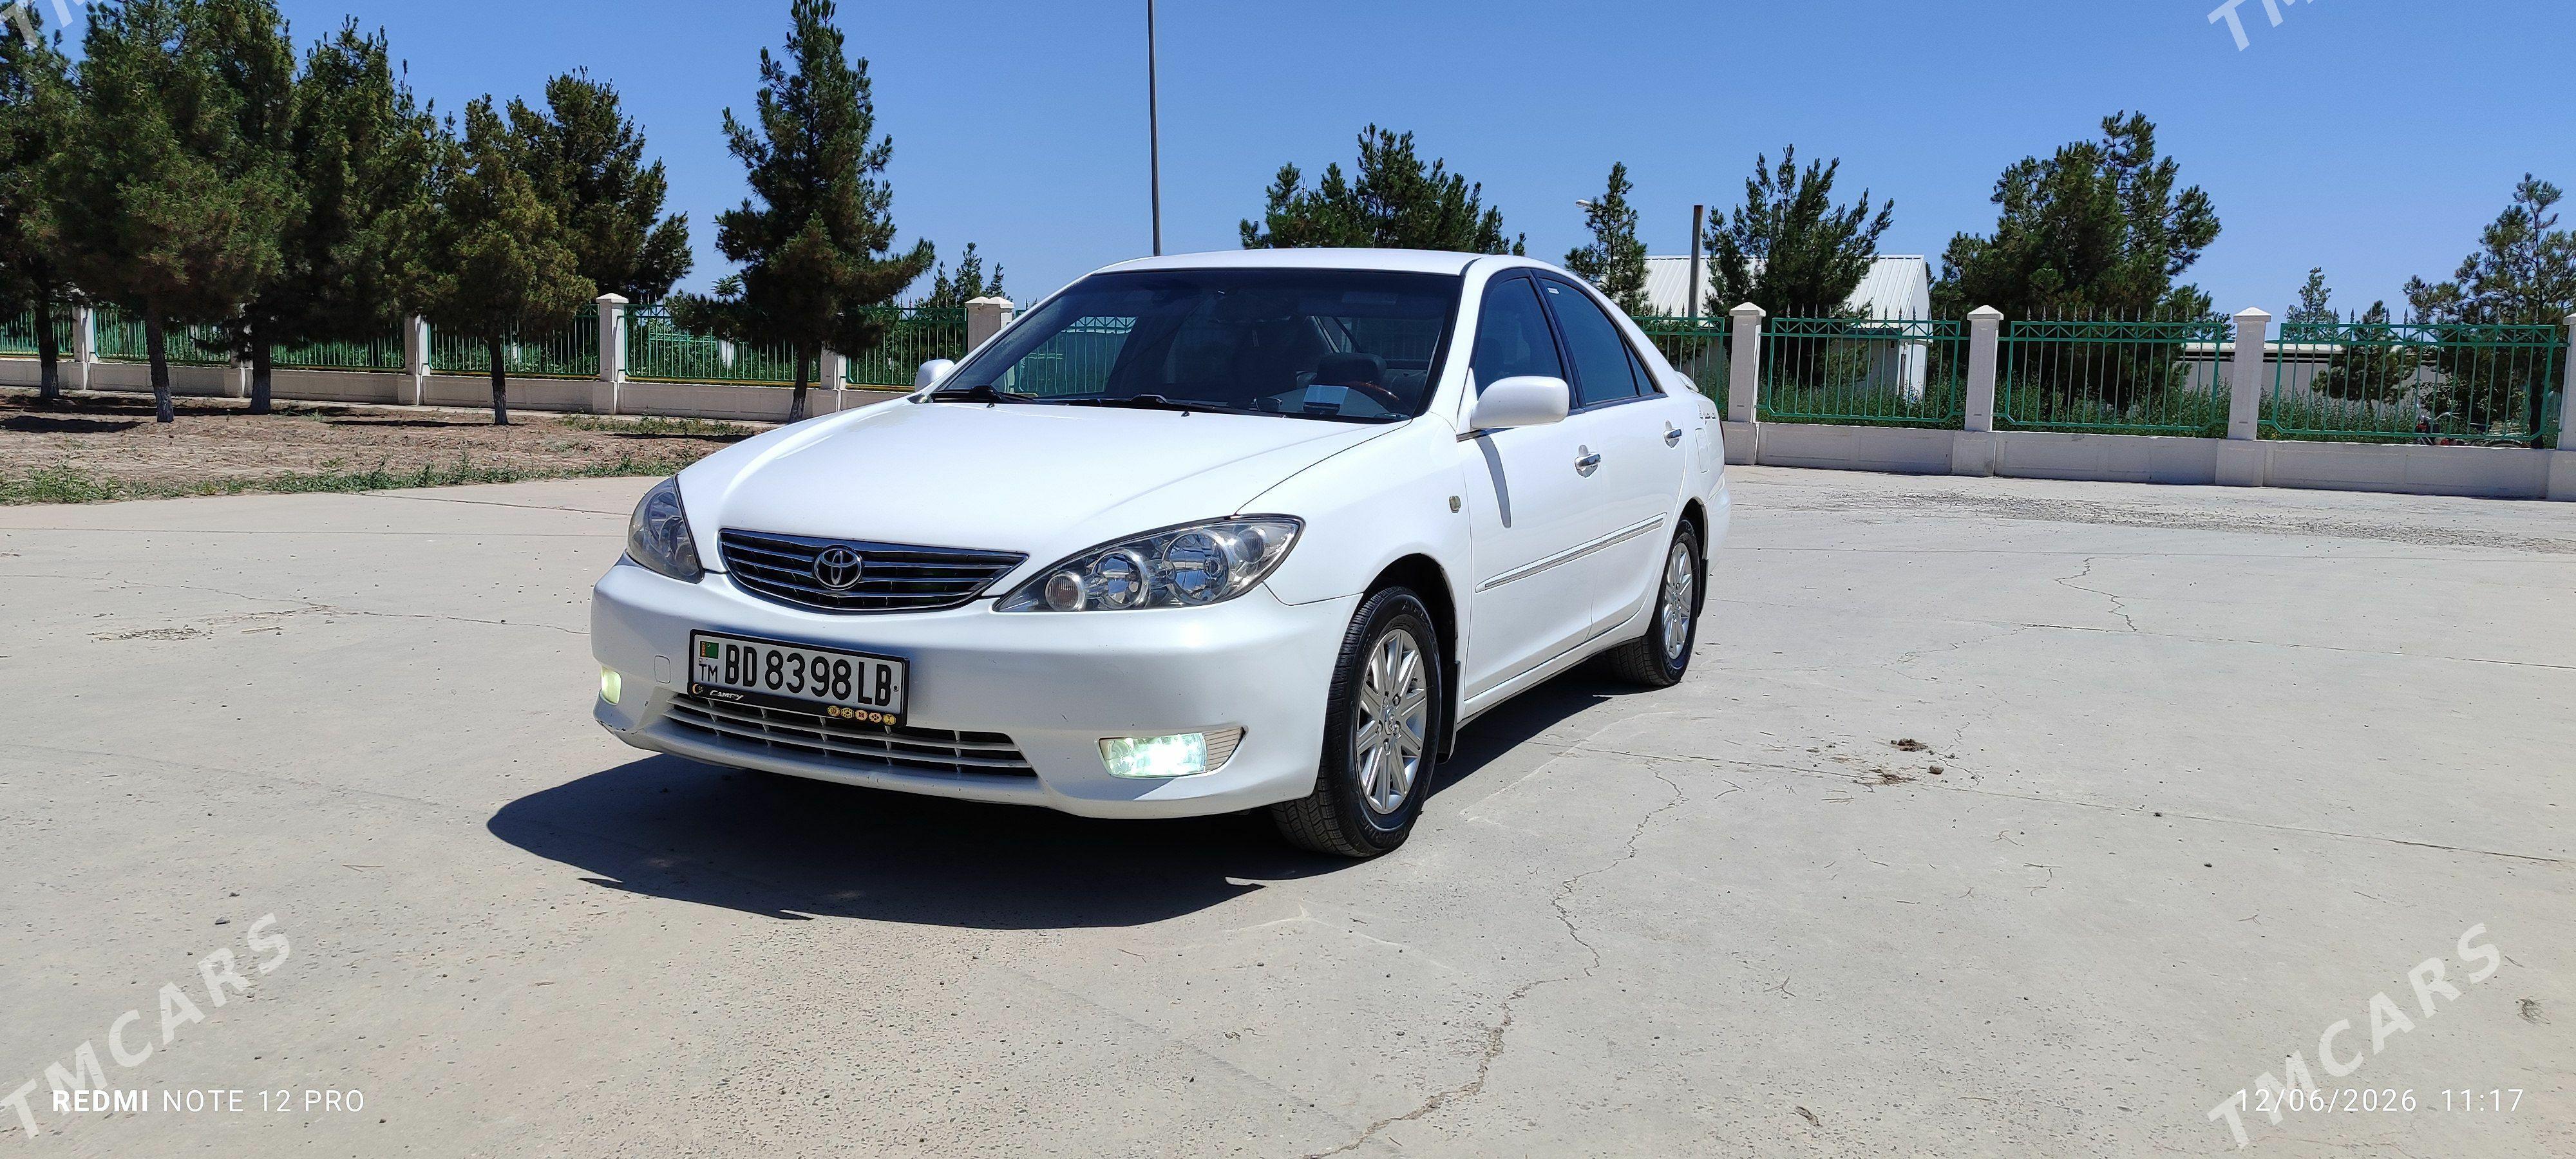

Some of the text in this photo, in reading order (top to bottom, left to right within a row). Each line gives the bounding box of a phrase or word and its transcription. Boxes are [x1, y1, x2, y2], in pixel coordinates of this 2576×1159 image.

[699, 663, 718, 683] TM
[725, 645, 892, 707] BD 8398 LB
